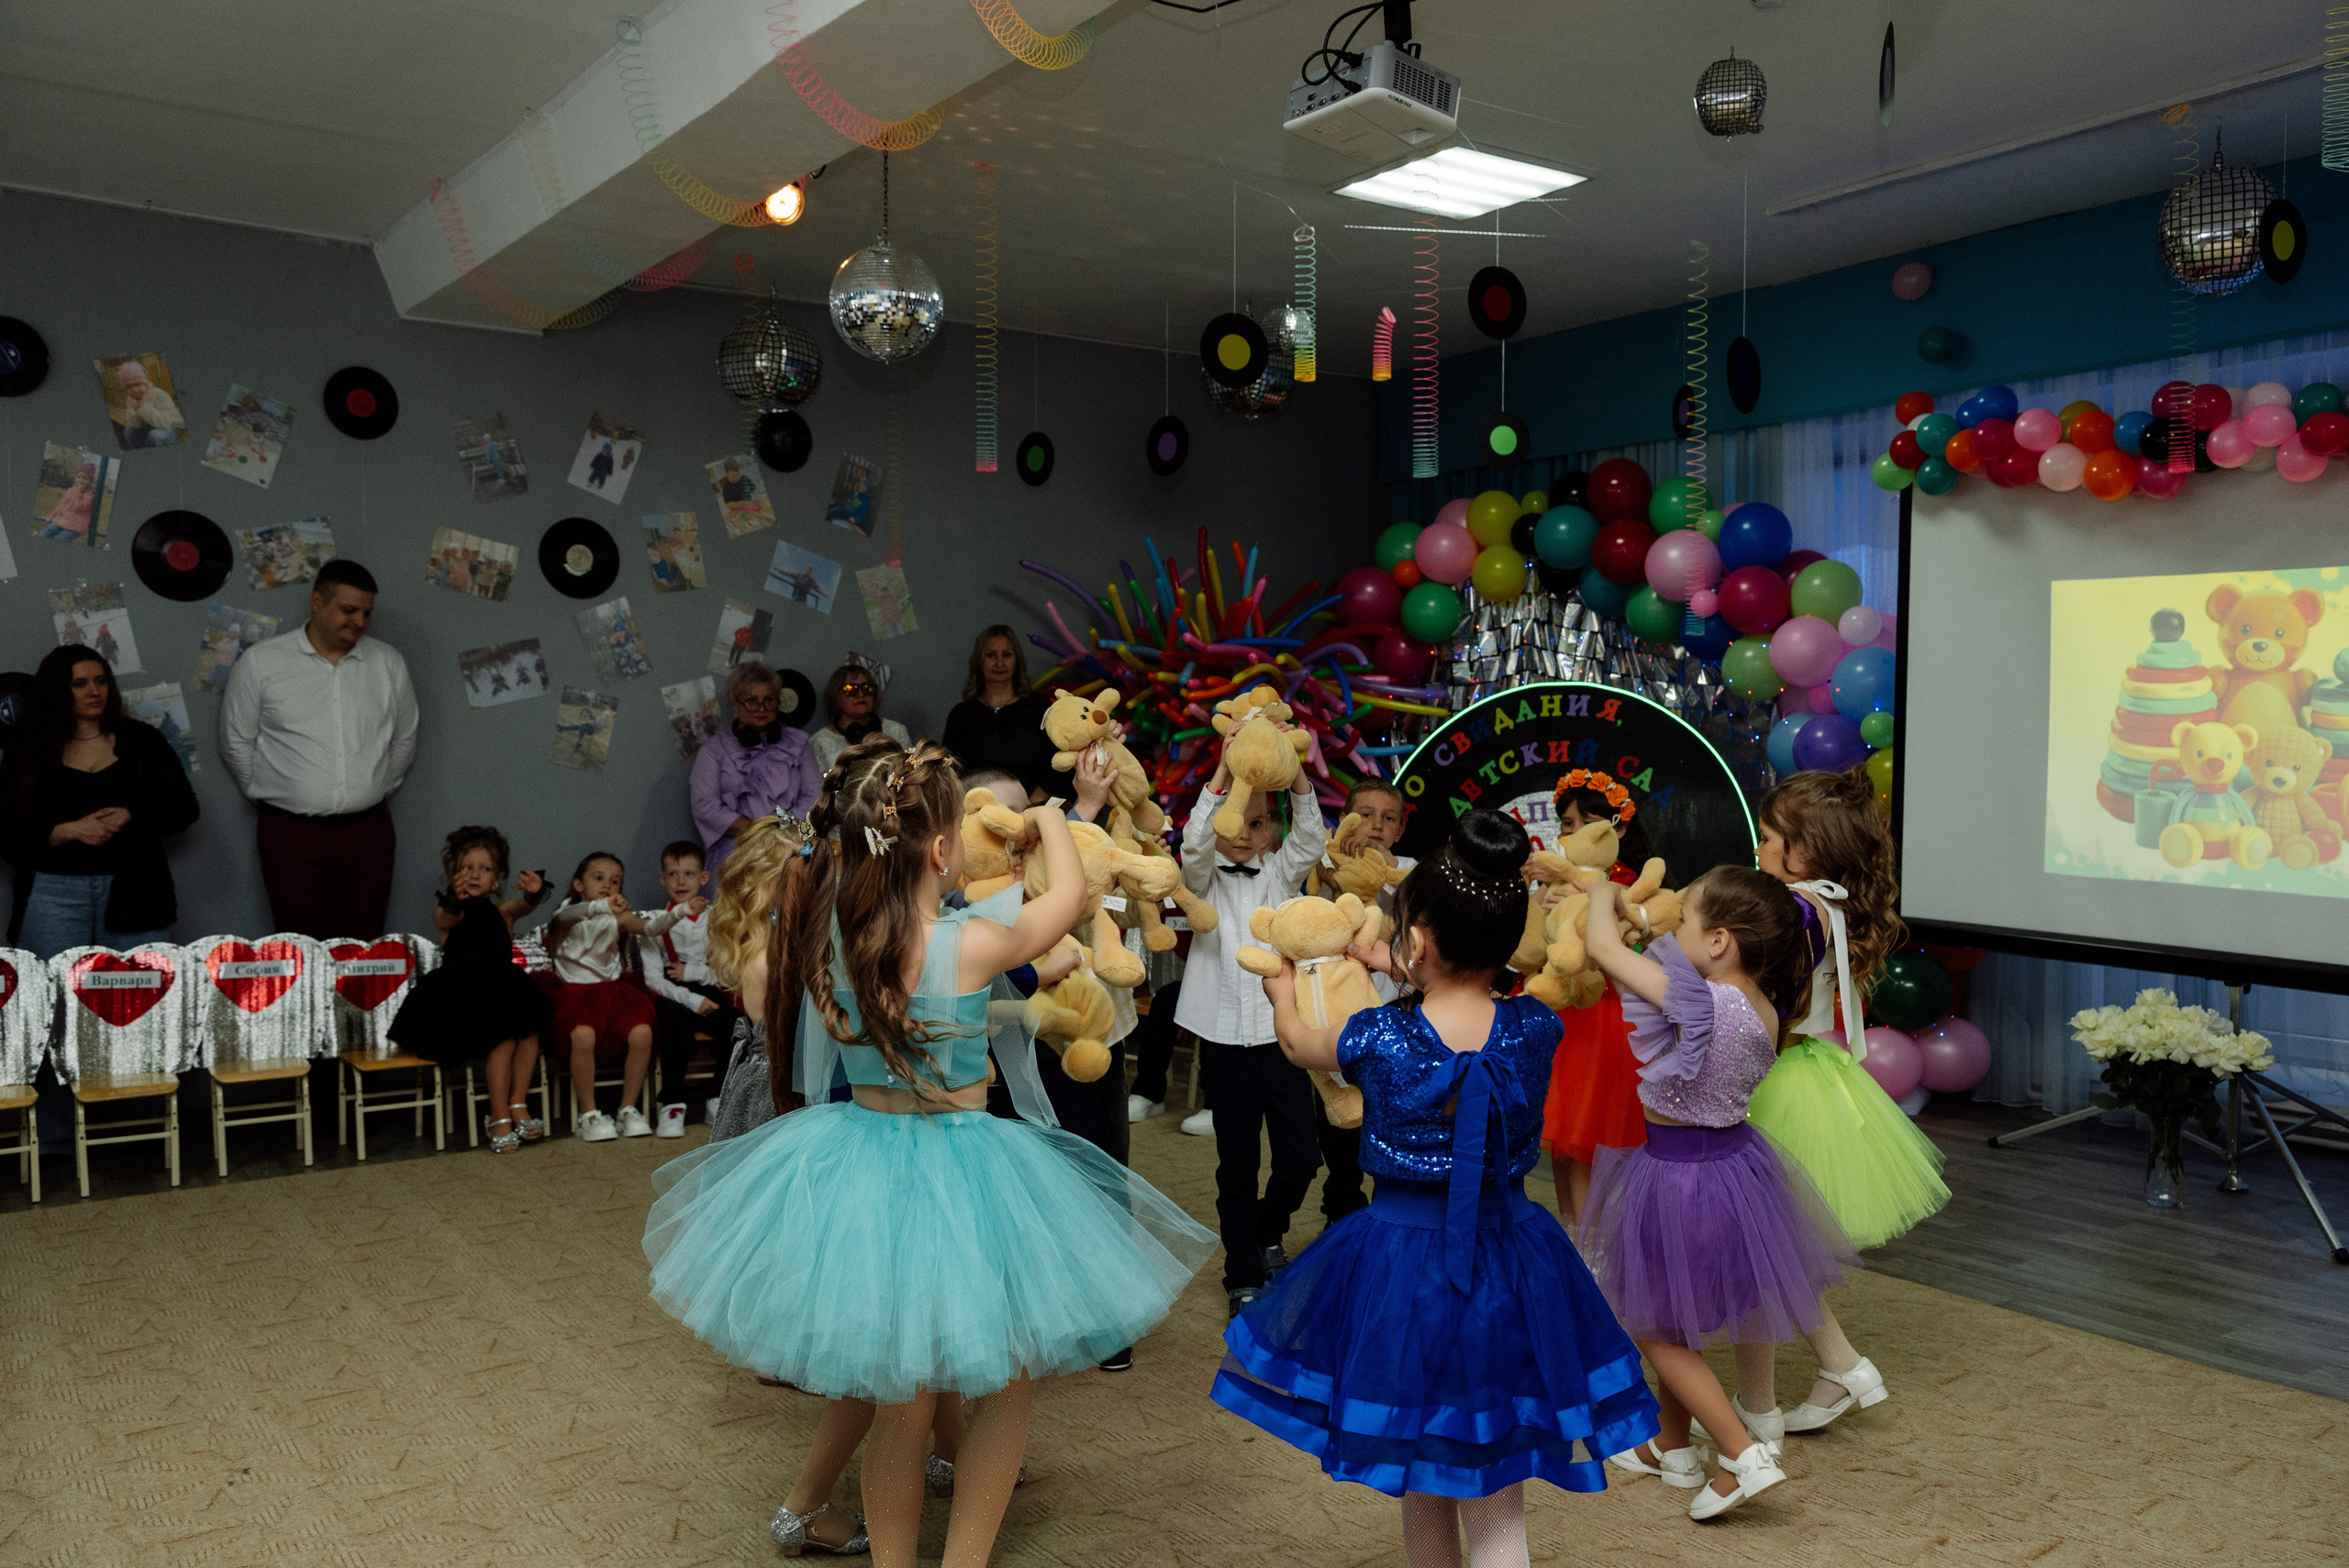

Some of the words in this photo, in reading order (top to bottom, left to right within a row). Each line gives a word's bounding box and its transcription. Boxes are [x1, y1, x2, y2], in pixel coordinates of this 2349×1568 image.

[1434, 695, 1622, 766] СВИДАНИЯ,
[1449, 738, 1599, 818] ДЕТСКИЙ
[1617, 755, 1675, 811] САД
[92, 975, 152, 989] Варвара
[235, 965, 280, 977] София
